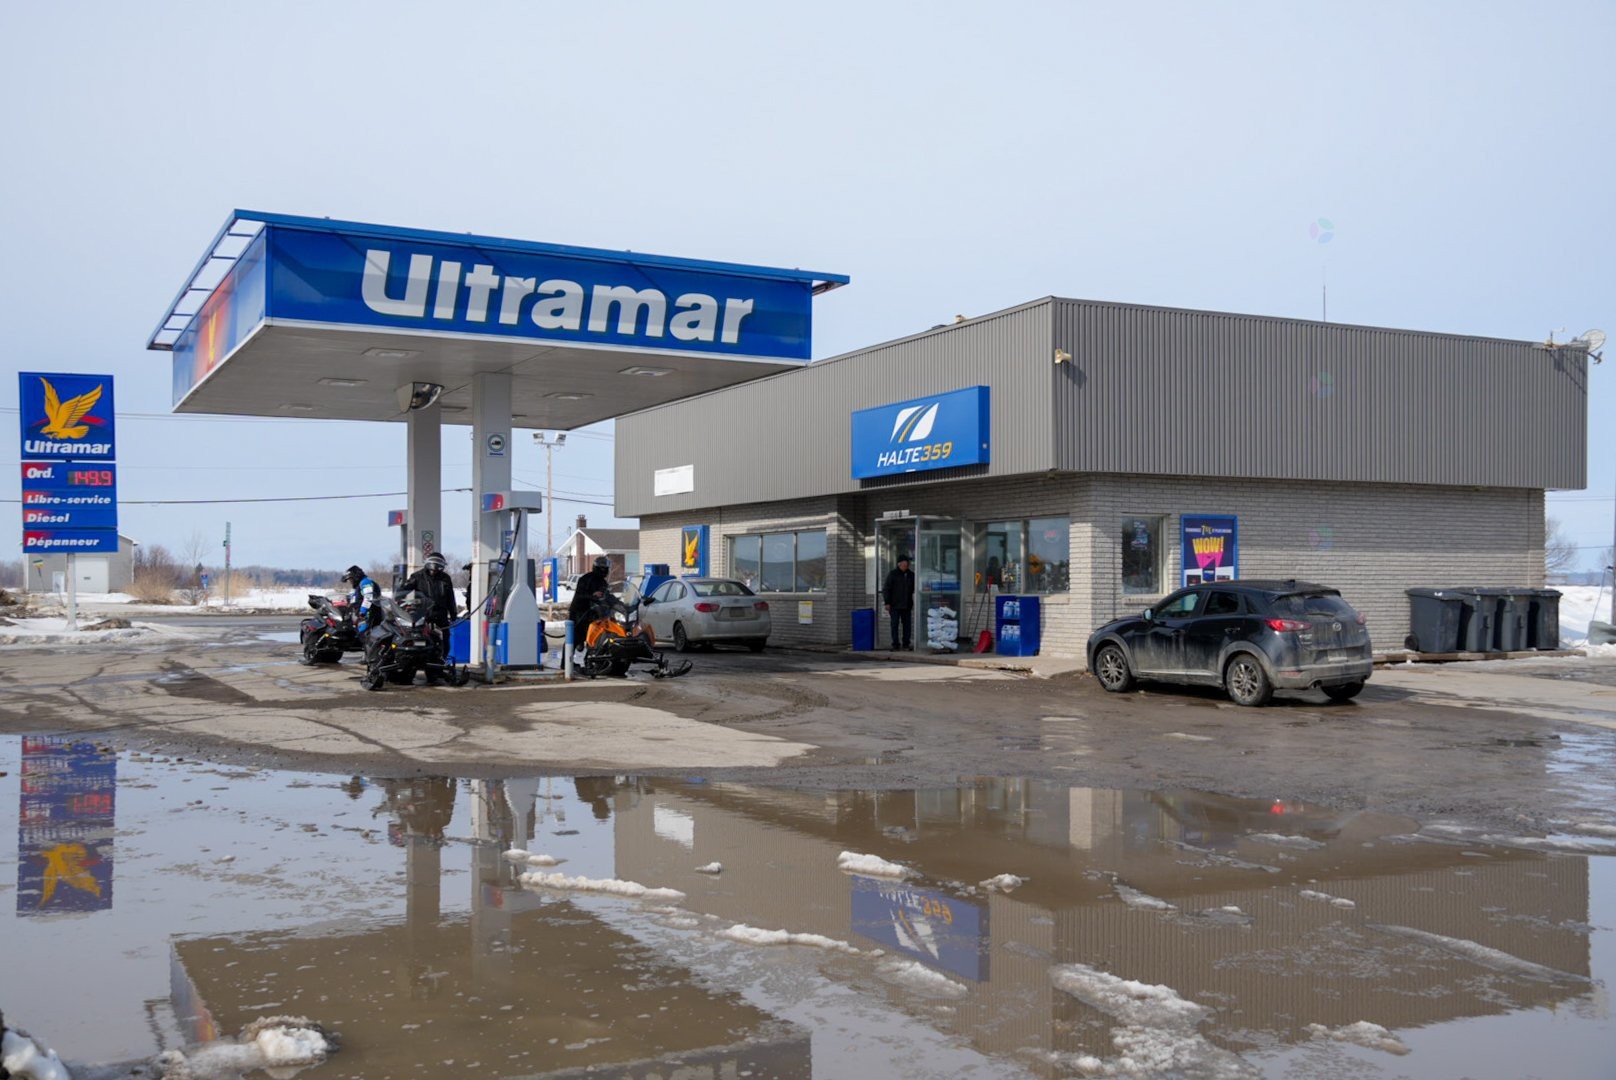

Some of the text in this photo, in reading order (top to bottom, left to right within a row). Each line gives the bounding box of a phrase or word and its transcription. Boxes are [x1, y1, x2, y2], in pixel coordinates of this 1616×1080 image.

[361, 249, 753, 344] Ultramar
[24, 440, 111, 453] Ultramar
[877, 441, 952, 467] HALTE359
[27, 467, 112, 485] Ord. 149.9
[27, 495, 111, 504] Libre-service
[27, 513, 69, 522] Diesel
[27, 537, 99, 548] Dépanneur
[1192, 536, 1224, 554] WOW!
